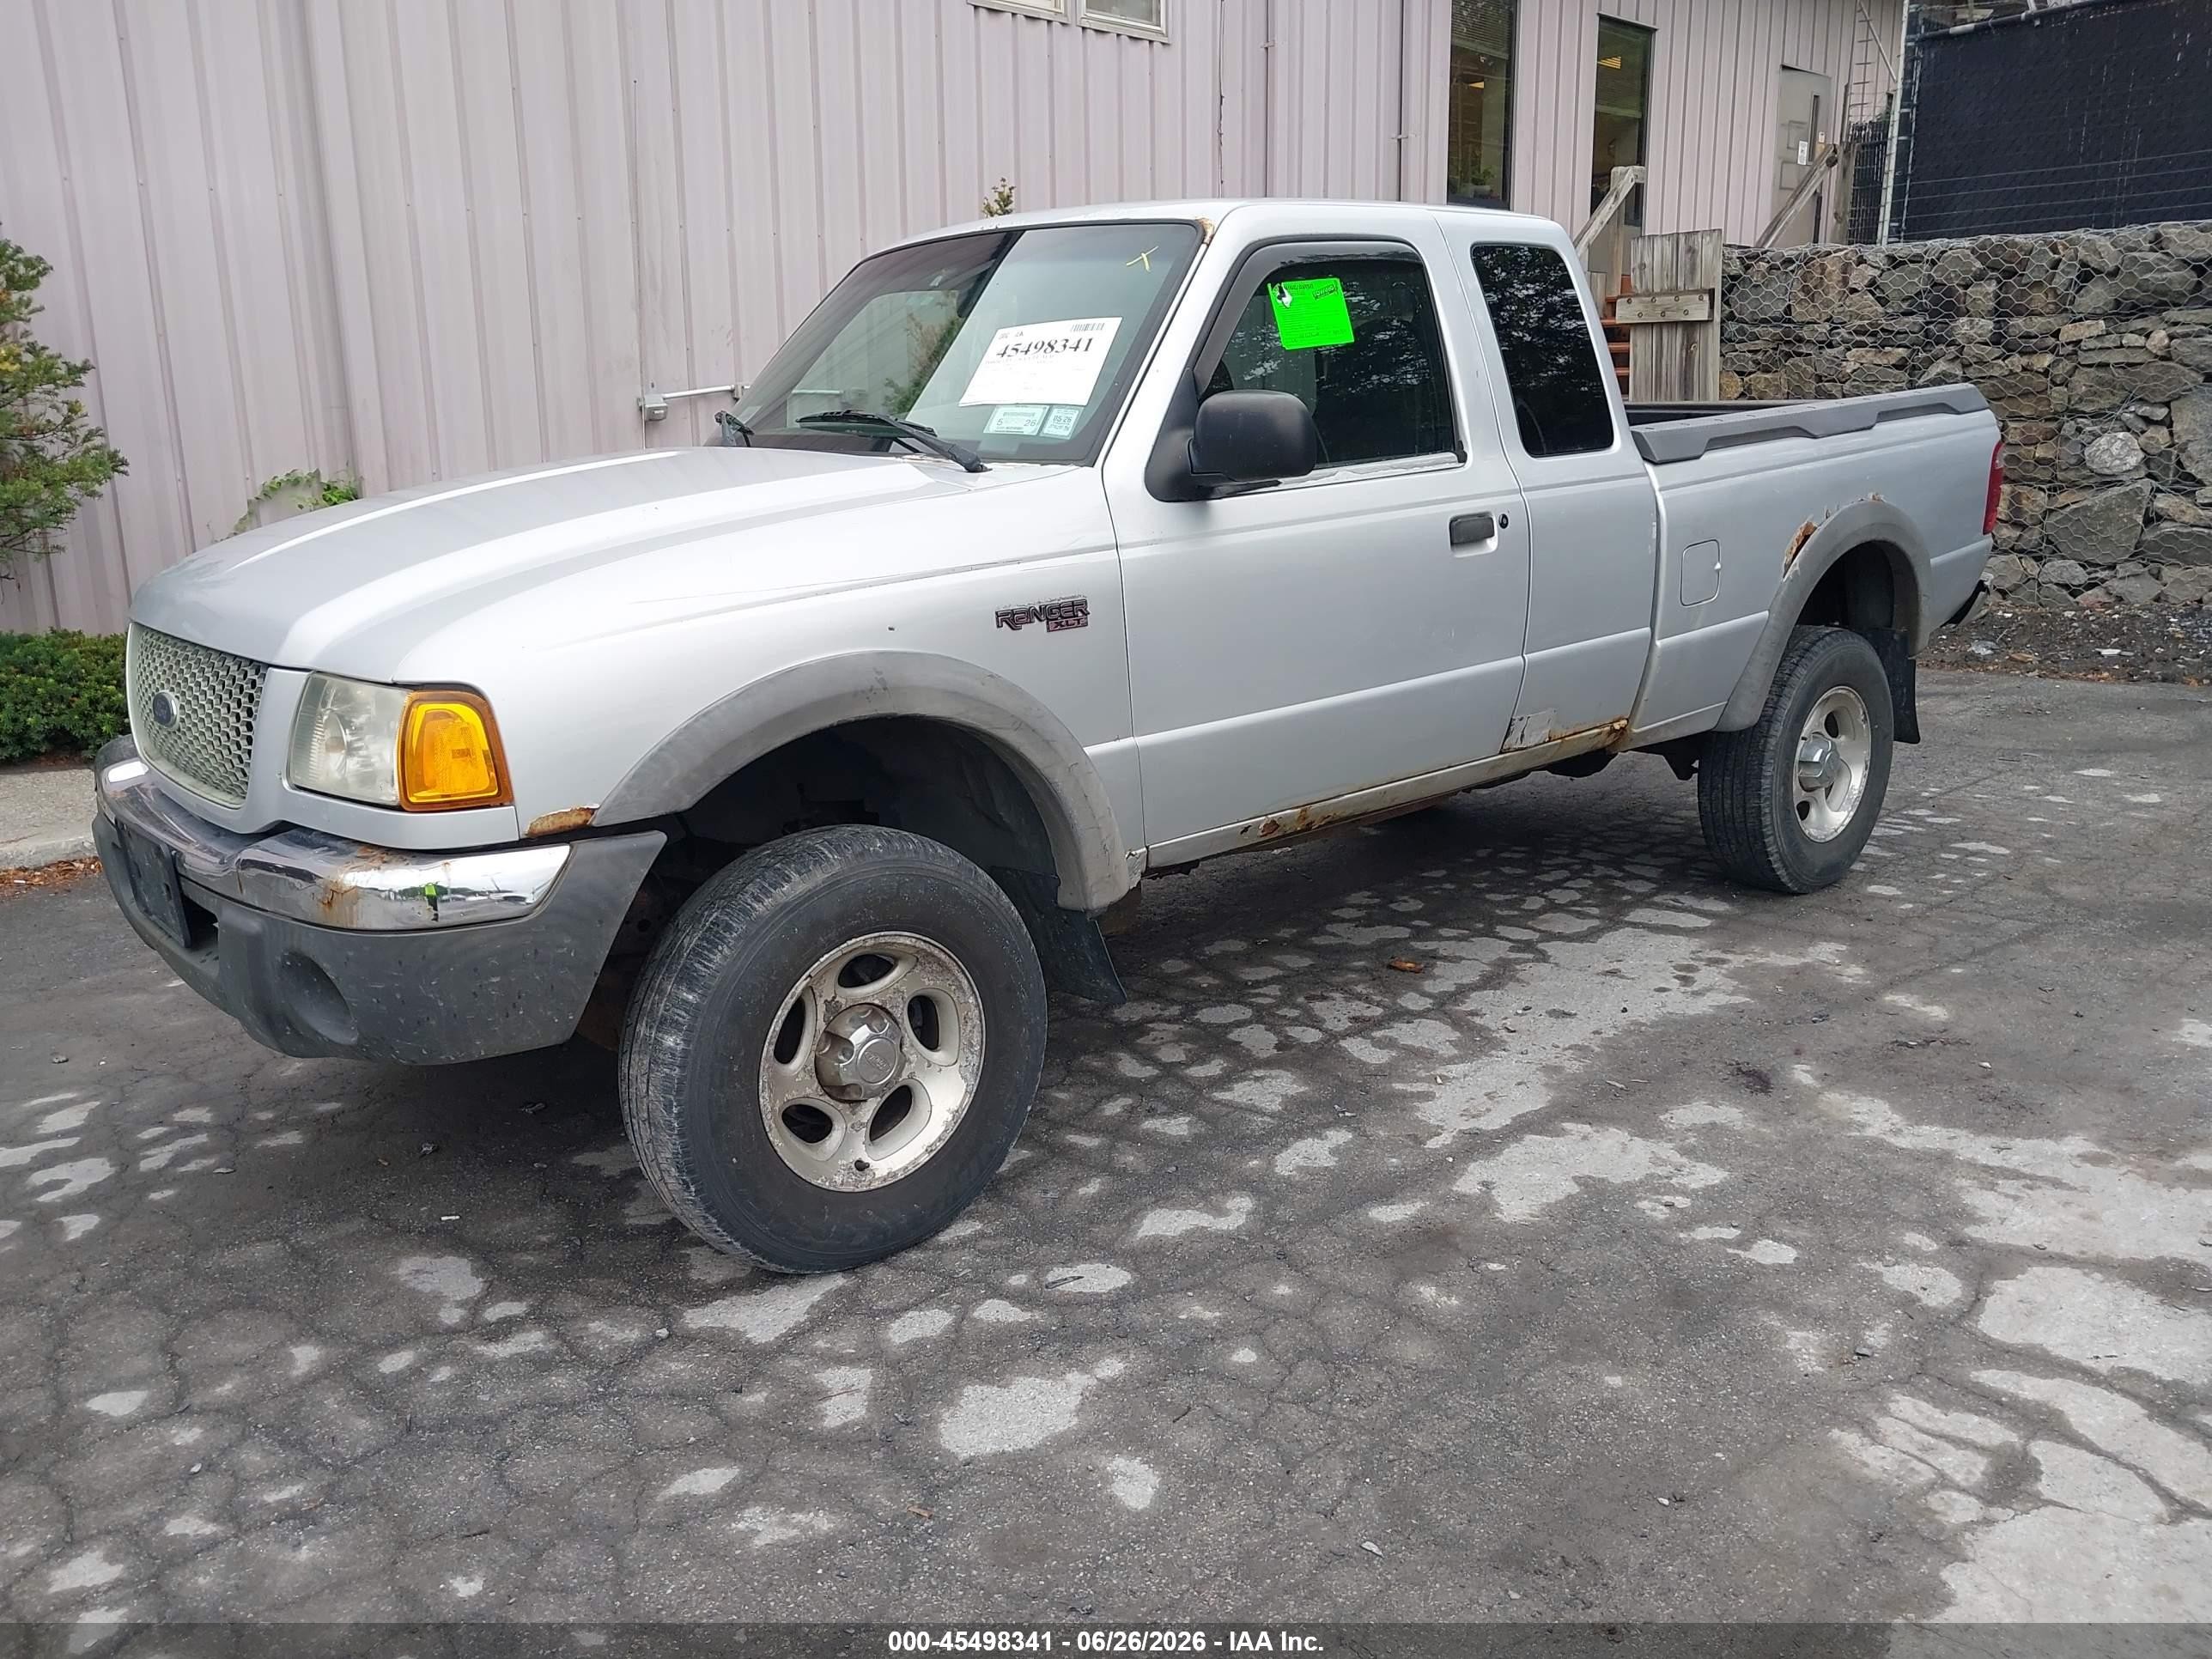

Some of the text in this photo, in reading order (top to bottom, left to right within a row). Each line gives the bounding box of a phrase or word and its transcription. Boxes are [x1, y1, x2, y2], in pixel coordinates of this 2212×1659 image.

[995, 337, 1093, 358] 45498341
[1024, 418, 1037, 428] 26
[995, 599, 1090, 630] RANGER
[1050, 617, 1085, 630] XLT
